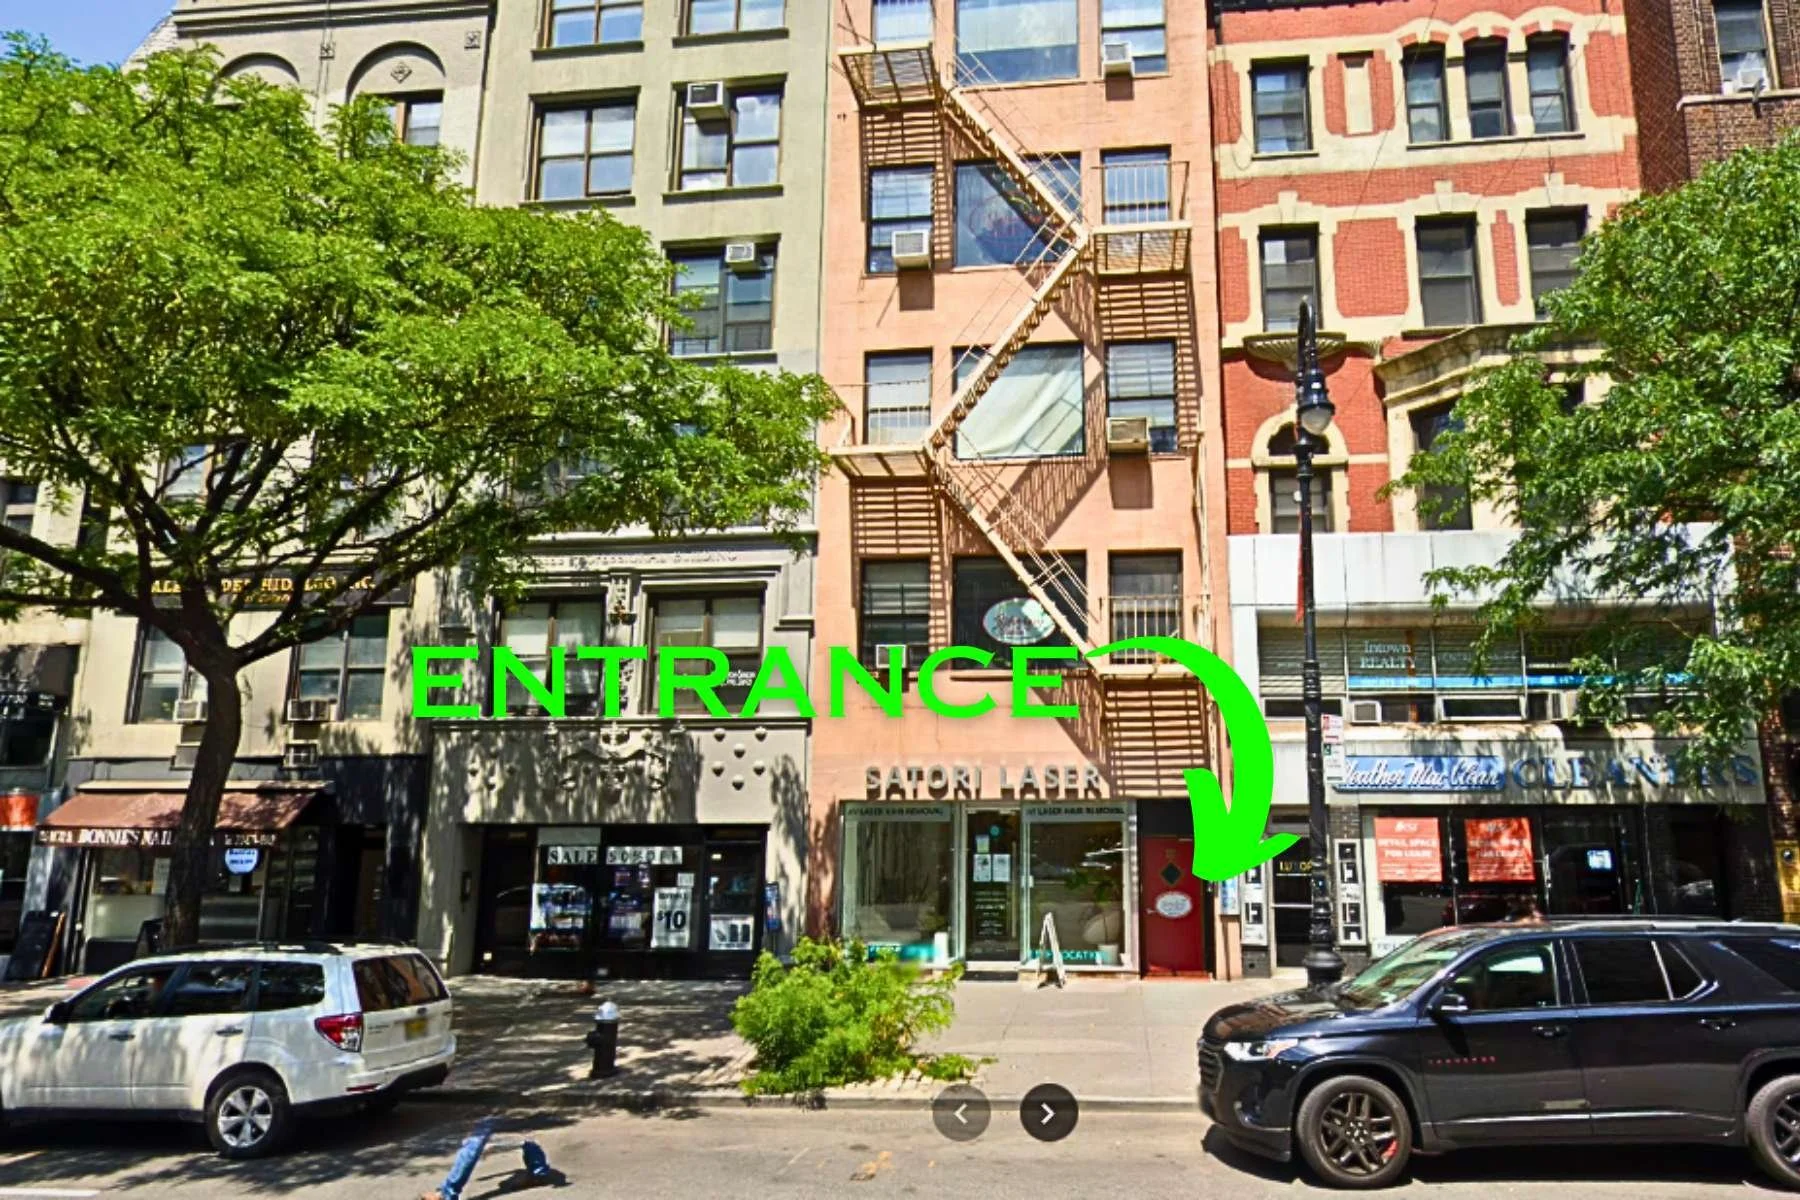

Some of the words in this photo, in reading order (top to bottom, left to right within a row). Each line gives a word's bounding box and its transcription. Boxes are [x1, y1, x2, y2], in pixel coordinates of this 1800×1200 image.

[1360, 656, 1416, 669] REALTY
[866, 765, 982, 791] SATORI
[1000, 765, 1100, 791] LASER
[1512, 756, 1760, 790] CLEANRS
[550, 849, 597, 864] SALE
[657, 910, 686, 930] $10
